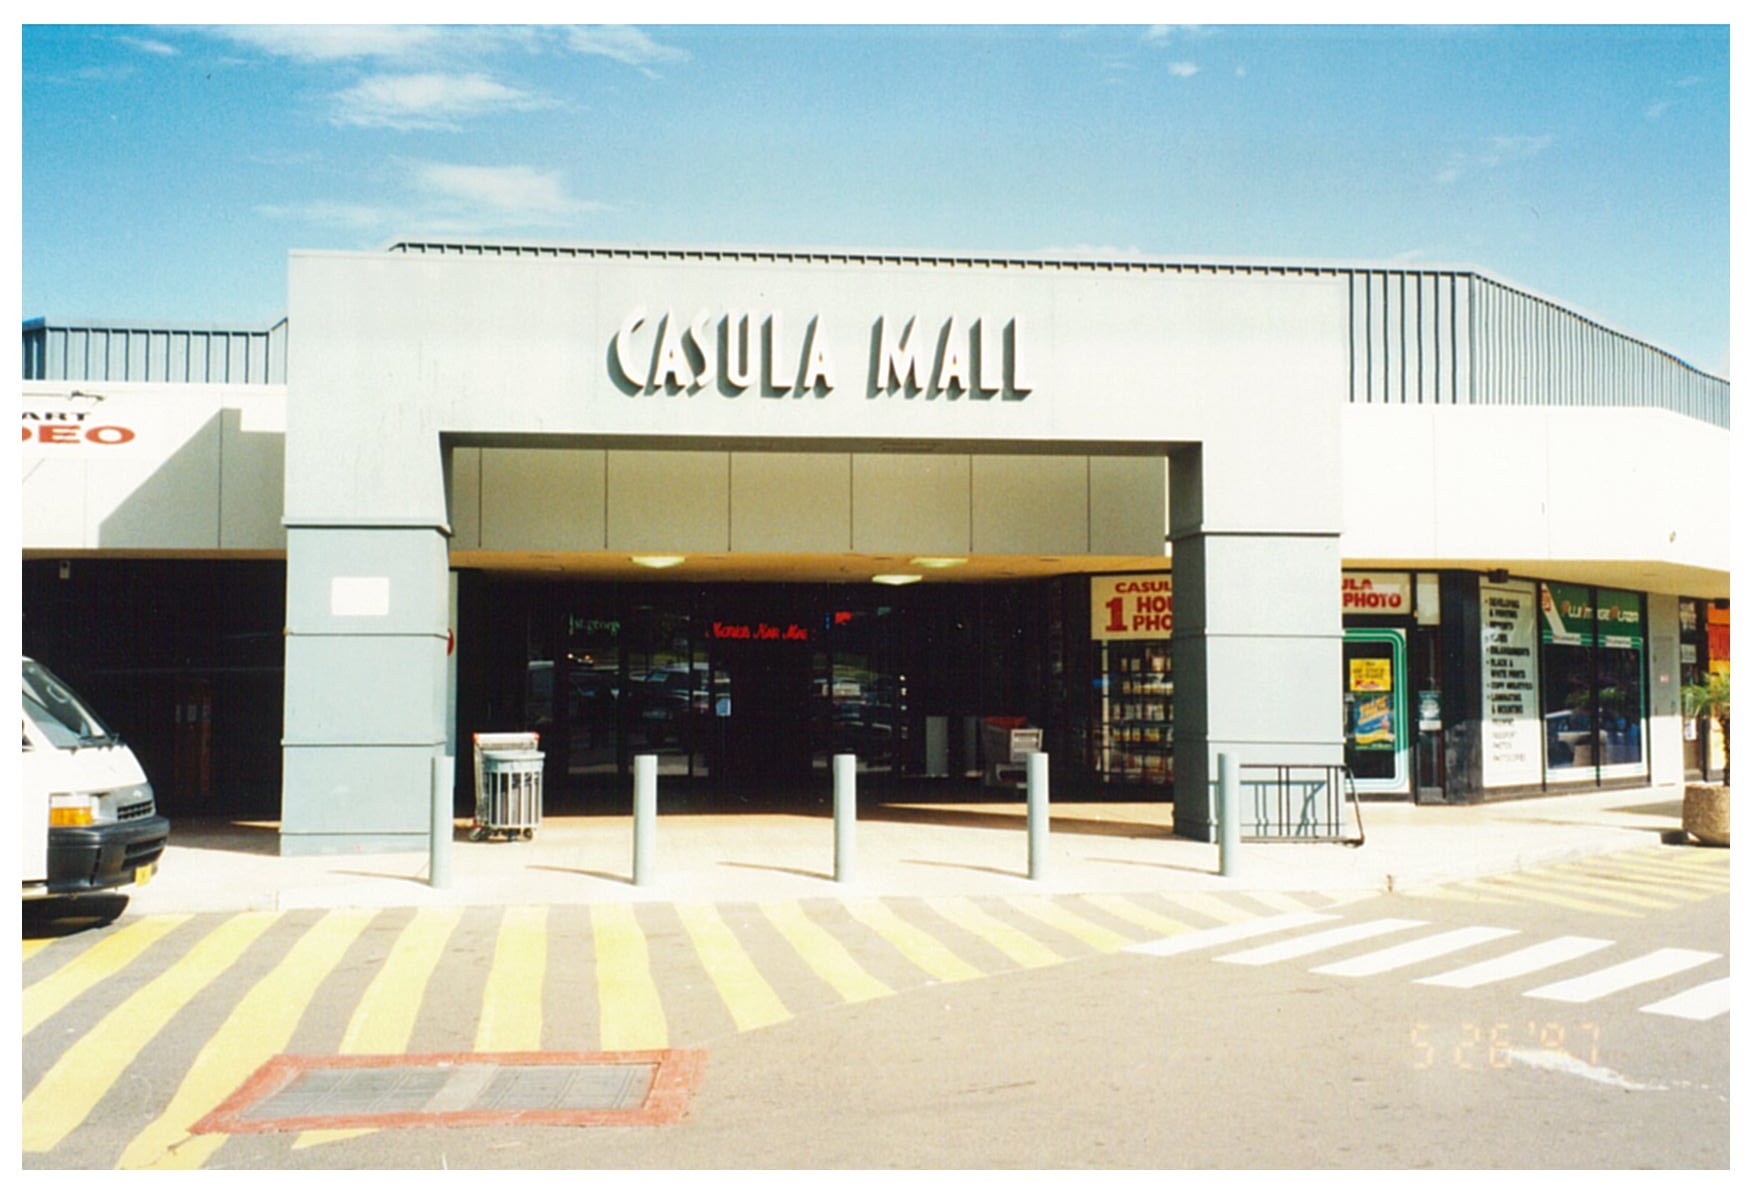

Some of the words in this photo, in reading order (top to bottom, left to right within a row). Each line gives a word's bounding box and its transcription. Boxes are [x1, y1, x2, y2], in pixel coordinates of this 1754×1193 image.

[606, 308, 835, 399] CASULA
[866, 311, 1035, 401] MALL
[22, 424, 136, 445] EO
[1114, 581, 1172, 593] CASUL
[1342, 592, 1402, 608] PHOTO
[1105, 597, 1128, 632] 1
[1136, 595, 1173, 613] HO
[1132, 614, 1173, 631] PHO
